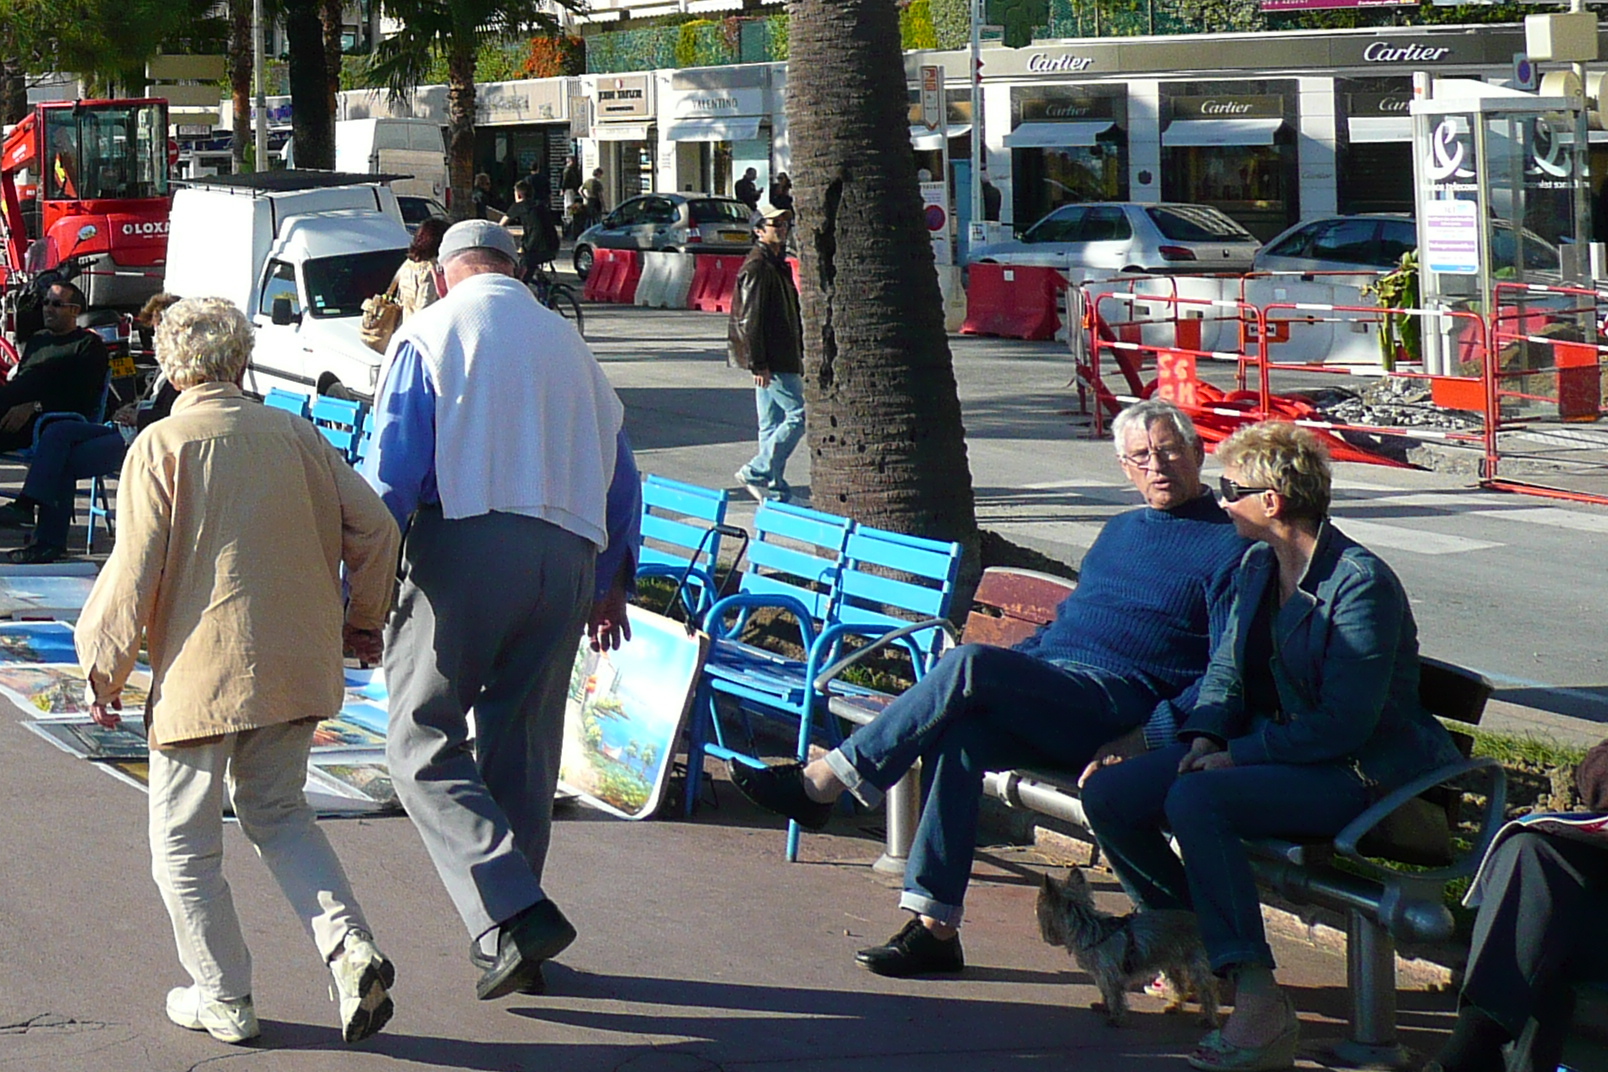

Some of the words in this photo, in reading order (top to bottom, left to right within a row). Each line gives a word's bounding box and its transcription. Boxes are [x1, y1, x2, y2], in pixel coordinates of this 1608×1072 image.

[1363, 40, 1450, 62] Cartier
[1026, 52, 1095, 73] Cartier
[692, 96, 739, 110] VALENTINO
[1045, 103, 1090, 117] Cartier
[1201, 99, 1254, 114] Cartier
